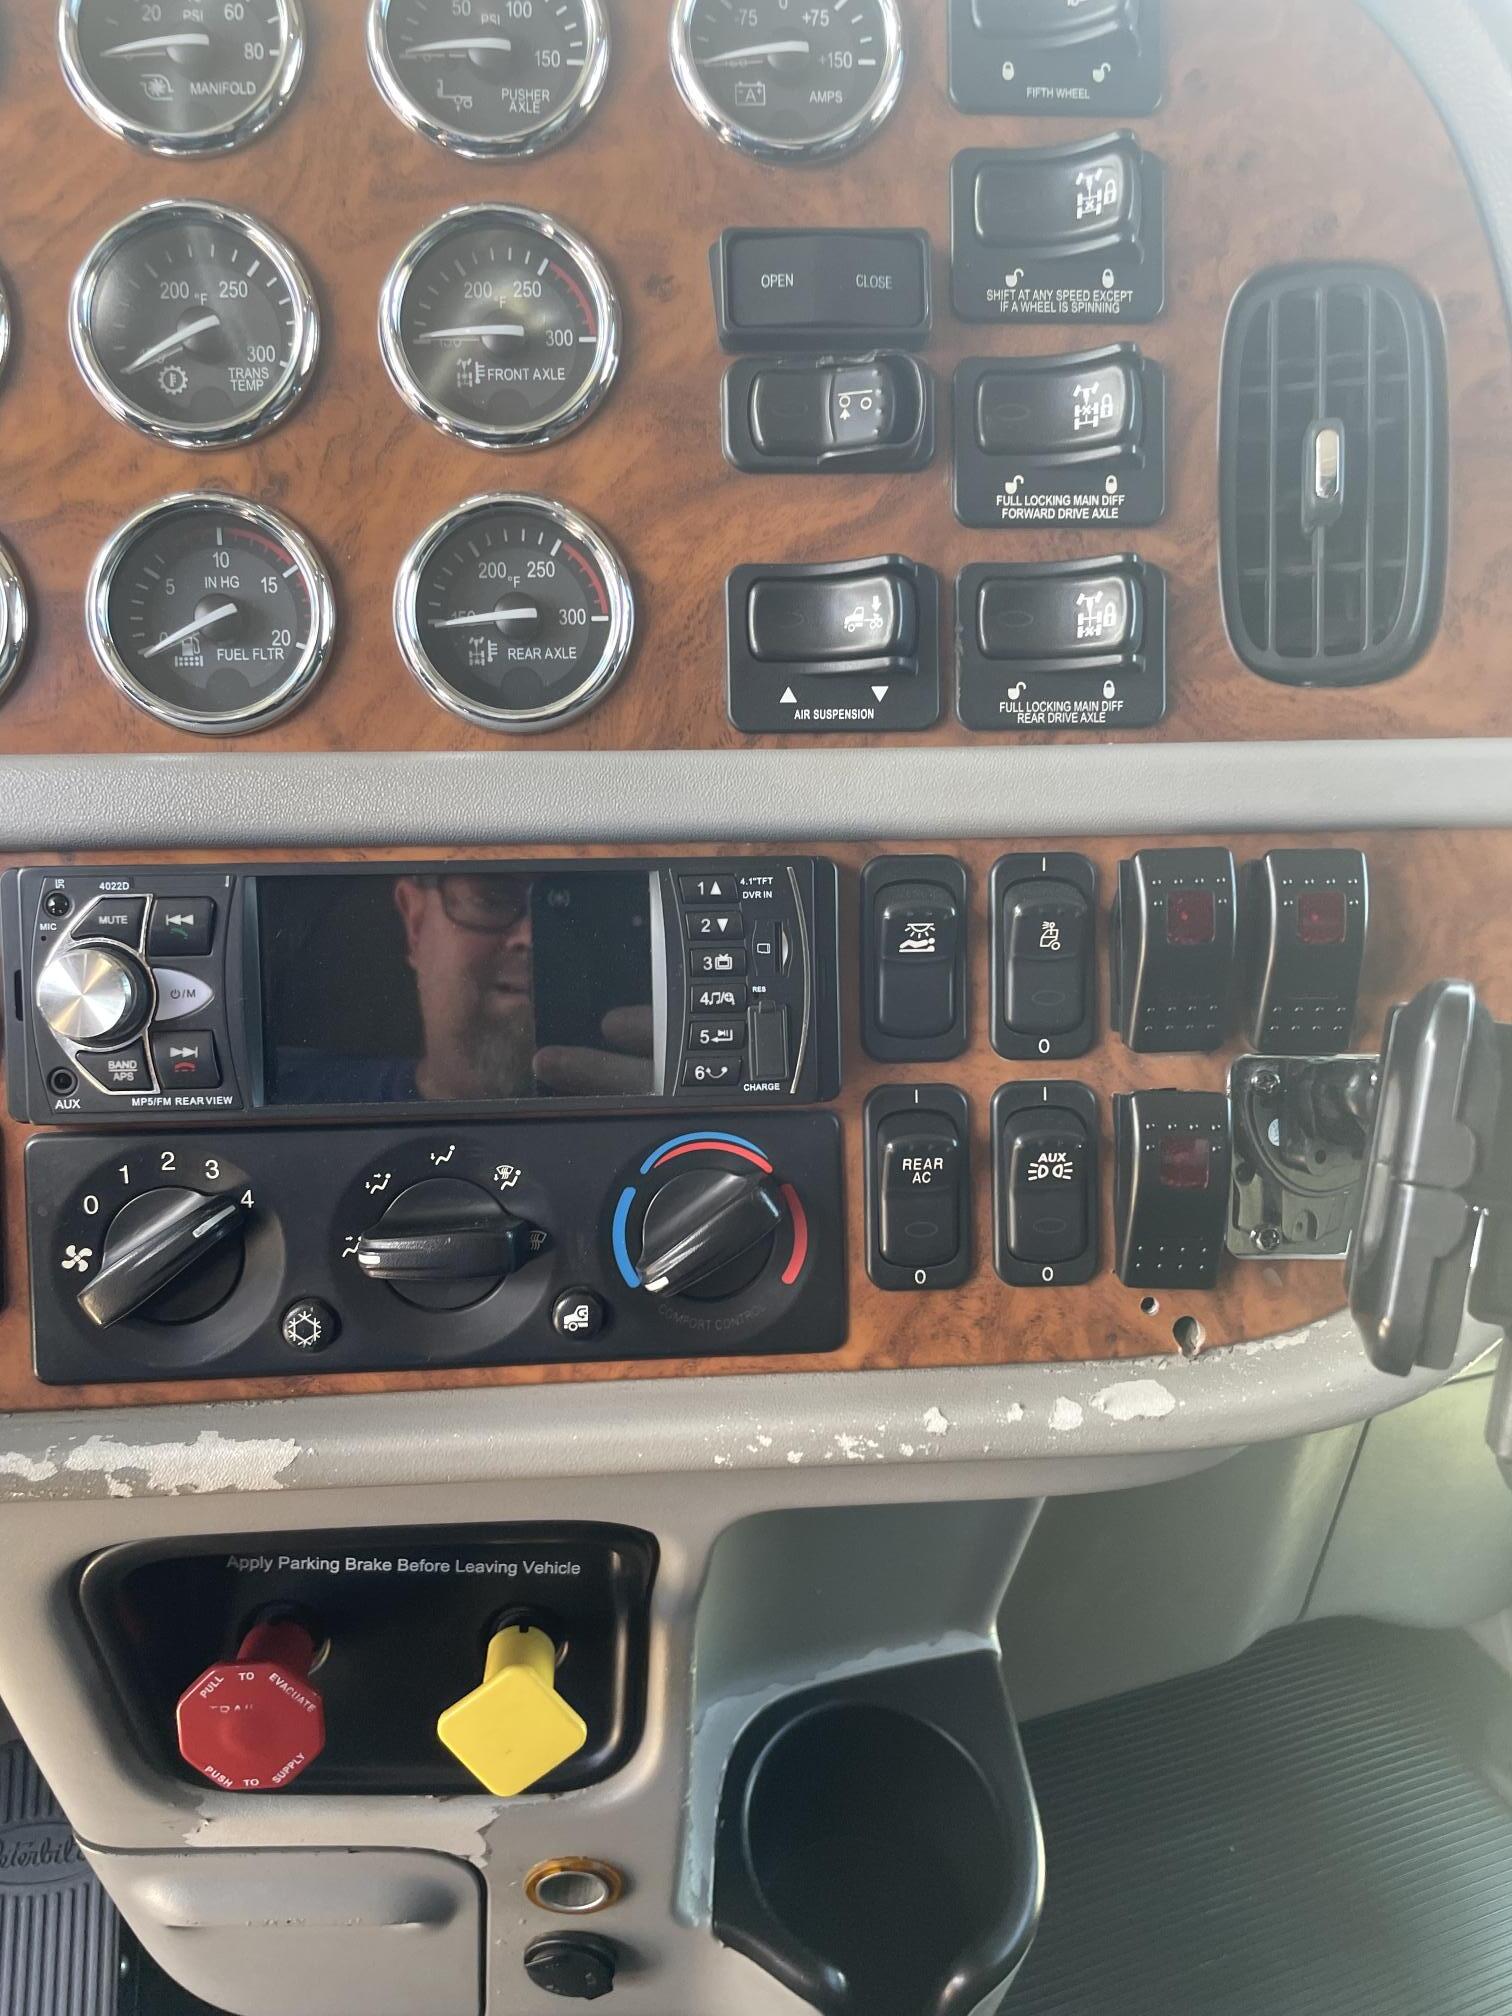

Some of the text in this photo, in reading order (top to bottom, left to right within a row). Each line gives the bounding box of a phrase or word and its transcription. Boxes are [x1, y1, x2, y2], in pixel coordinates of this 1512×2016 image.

[142, 4, 161, 21] 20
[183, 10, 204, 22] PSI
[224, 3, 244, 21] 60
[452, 1, 471, 16] 50
[506, 1, 533, 18] 100
[481, 14, 500, 25] PSI
[802, 9, 830, 26] +75
[244, 42, 264, 60] 80
[534, 51, 561, 67] 150
[819, 52, 852, 68] +150
[190, 82, 256, 96] MANIFOLD
[501, 88, 551, 101] PUSHER
[1026, 86, 1090, 100] FIFTH WHEEL
[809, 90, 843, 104] AMPS
[509, 102, 541, 114] AXLE
[761, 273, 794, 288] OPEN
[856, 274, 893, 290] CLOSE
[160, 282, 189, 299] 200
[219, 281, 248, 298] 250
[464, 281, 493, 298] 200
[513, 281, 542, 298] 250
[986, 289, 1133, 302] SHIFT AT ANY SPEED EXCEPT
[1000, 302, 1120, 314] IF A WHEEL IS SPINNING
[546, 329, 573, 346] 300
[247, 345, 276, 362] 300
[228, 367, 269, 379] TRANS
[487, 368, 566, 381] FRONT AXLE
[230, 380, 264, 391] TEMP
[996, 495, 1125, 506] FULL LOCKING MAIN DIFF
[1002, 508, 1119, 519] FORWARD DRIVE AXLE
[212, 551, 230, 568] 10
[478, 562, 507, 578] 200
[527, 561, 556, 578] 250
[166, 579, 175, 595] 5
[204, 576, 240, 588] IN HG
[261, 577, 278, 593] 15
[559, 609, 586, 625] 300
[271, 630, 291, 646] 20
[217, 648, 285, 661] FUEL FLTR
[508, 647, 577, 660] REAR AXLE
[794, 709, 875, 720] AIR SUSPENSION
[1000, 701, 1124, 713] FULL LOCKING MAIN DIFF
[1018, 712, 1106, 724] REAR DRIVE AXLE
[99, 882, 130, 891] 4022D
[697, 881, 704, 895] 1
[742, 890, 773, 899] DVR IN
[40, 923, 57, 931] MIC
[98, 915, 128, 925] MUTE
[700, 918, 711, 933] 2
[703, 956, 713, 970] 3
[700, 1029, 710, 1044] 5
[108, 1060, 137, 1069] BAND
[113, 1072, 135, 1081] APS
[694, 1065, 705, 1080] 6
[743, 1083, 780, 1091] CHARGE
[55, 1099, 81, 1109] AUX
[132, 1096, 233, 1106] MP5/FM REAR VIEW
[161, 1151, 176, 1171] 2
[902, 1157, 944, 1171] REAR
[1037, 1152, 1067, 1163] AUX
[118, 1164, 130, 1184] 1
[205, 1159, 220, 1180] 3
[912, 1172, 932, 1184] AC
[83, 1195, 99, 1215] 0
[240, 1190, 254, 1208] 4
[658, 1303, 767, 1331] COMFORT CONTROL
[226, 1555, 581, 1577] Apply Parking Brake Before Leaving Vehicle
[200, 1675, 224, 1698] PULL
[238, 1672, 255, 1681] TO
[268, 1673, 317, 1713] EVACUATE
[204, 1752, 305, 1787] PUSH TO SUPPLY
